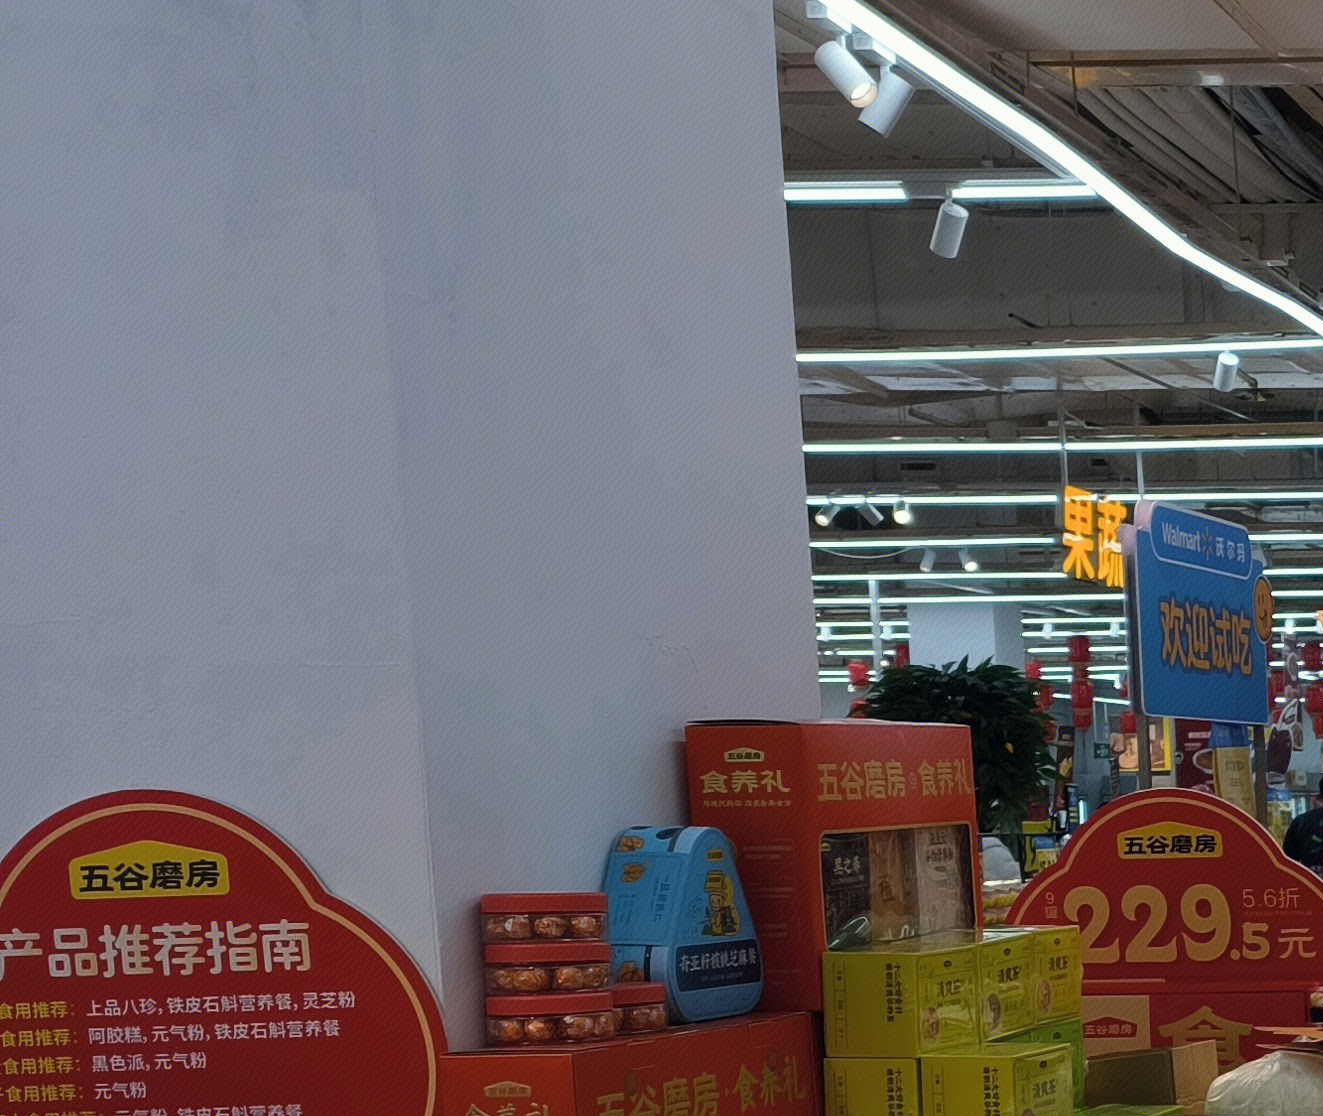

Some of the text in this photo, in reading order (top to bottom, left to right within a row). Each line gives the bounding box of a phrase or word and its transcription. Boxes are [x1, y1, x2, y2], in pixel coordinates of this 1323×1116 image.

[1161, 522, 1200, 552] Walmart
[1160, 598, 1252, 674] 欢迎试吃
[700, 769, 790, 794] 食养礼
[817, 758, 971, 801] 五谷磨房 食养礼
[1123, 834, 1217, 855] 五谷磨房
[79, 858, 220, 893] 五谷磨房
[1242, 888, 1300, 909] 5.6折
[0, 918, 312, 979] 产品推荐指南
[94, 1081, 147, 1100] 元气粉
[734, 1056, 807, 1113] 食养礼
